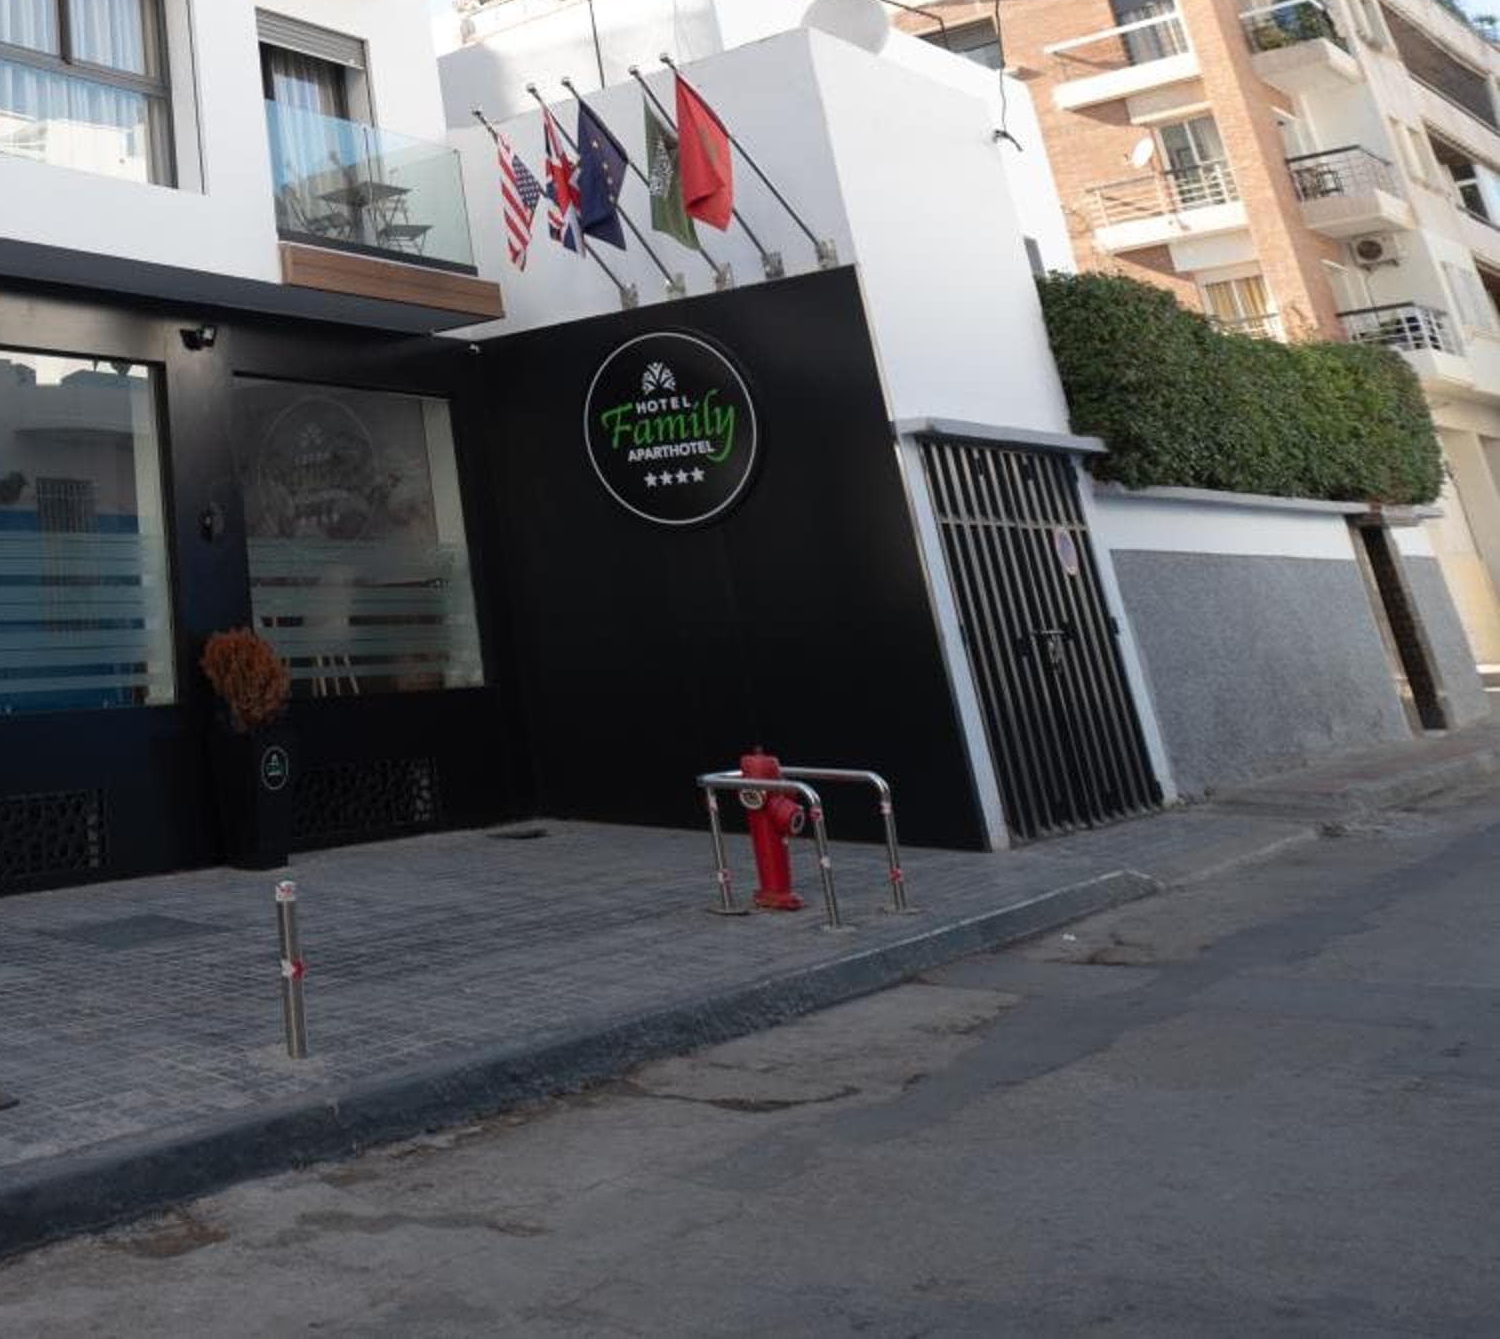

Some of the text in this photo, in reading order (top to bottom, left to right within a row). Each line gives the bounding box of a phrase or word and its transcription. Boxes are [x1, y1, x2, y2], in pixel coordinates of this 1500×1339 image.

[635, 395, 692, 414] HOTEL
[600, 389, 736, 464] Family
[627, 441, 715, 462] APARTHOTEL
